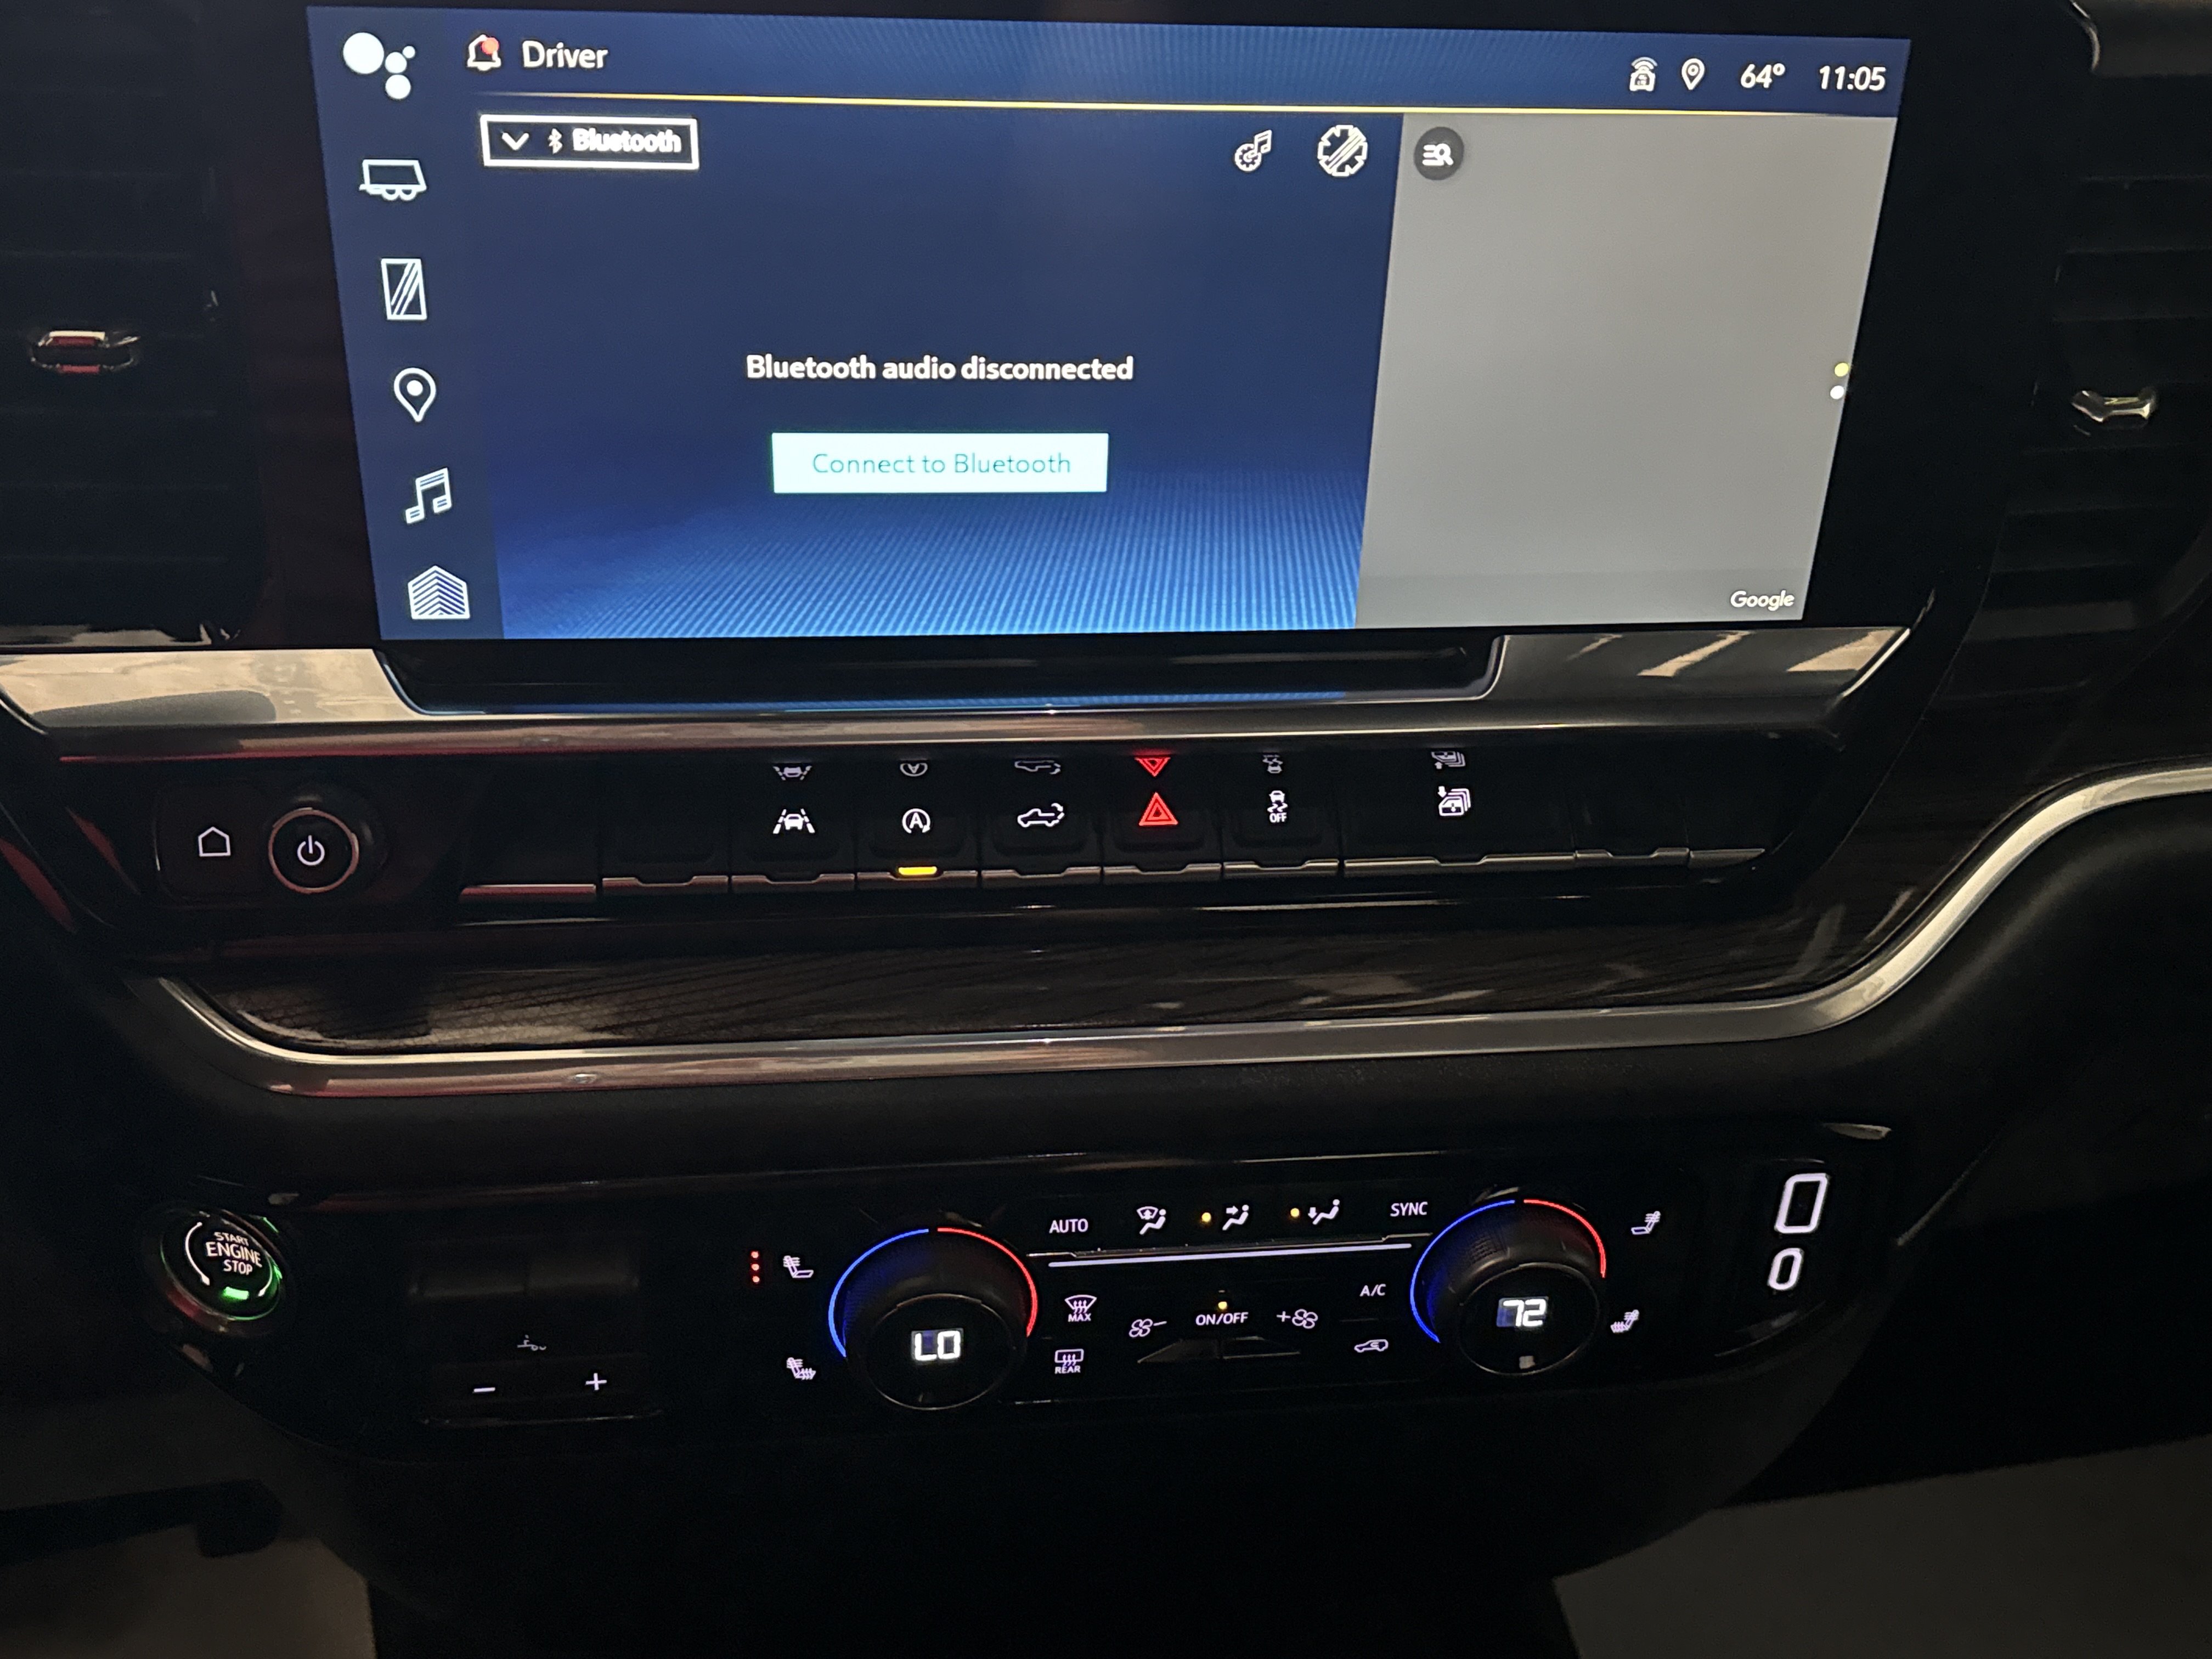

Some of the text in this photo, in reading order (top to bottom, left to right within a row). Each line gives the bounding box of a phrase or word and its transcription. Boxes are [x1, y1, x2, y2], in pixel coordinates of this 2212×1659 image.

[522, 41, 608, 69] Driver
[1820, 65, 1886, 91] 11:05
[572, 128, 682, 153] Bluetooth
[747, 354, 1134, 380] Bluetooth audio disconnected
[812, 453, 1071, 473] Connect to Bluetooth
[1730, 590, 1795, 611] Google
[1269, 812, 1287, 823] OFF
[1390, 1201, 1428, 1217] SYNC
[1049, 1218, 1088, 1233] AUTO
[214, 1232, 249, 1246] START
[206, 1241, 262, 1268] ENGINE
[223, 1259, 253, 1276] STOP
[1359, 1283, 1386, 1297] A/C
[1068, 1313, 1091, 1322] MAX
[1195, 1312, 1249, 1326] ON/OFF
[1503, 1299, 1547, 1327] 72
[1054, 1365, 1081, 1374] REAR
